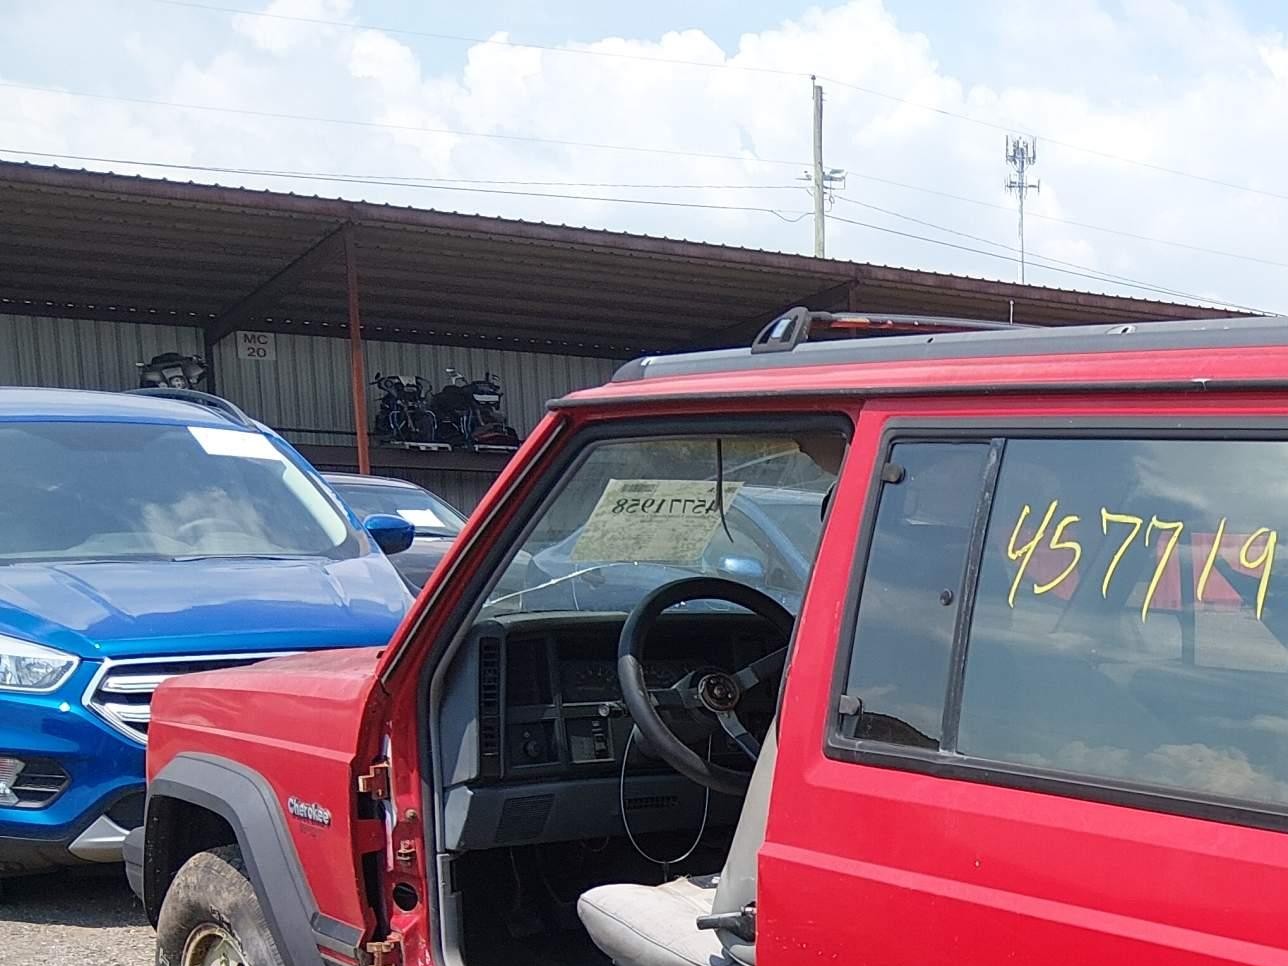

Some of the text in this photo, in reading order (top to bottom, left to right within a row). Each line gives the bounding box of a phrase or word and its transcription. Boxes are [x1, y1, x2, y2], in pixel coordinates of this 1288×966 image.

[243, 333, 269, 345] MC
[247, 346, 266, 358] 20
[287, 796, 331, 826] Cherokee
